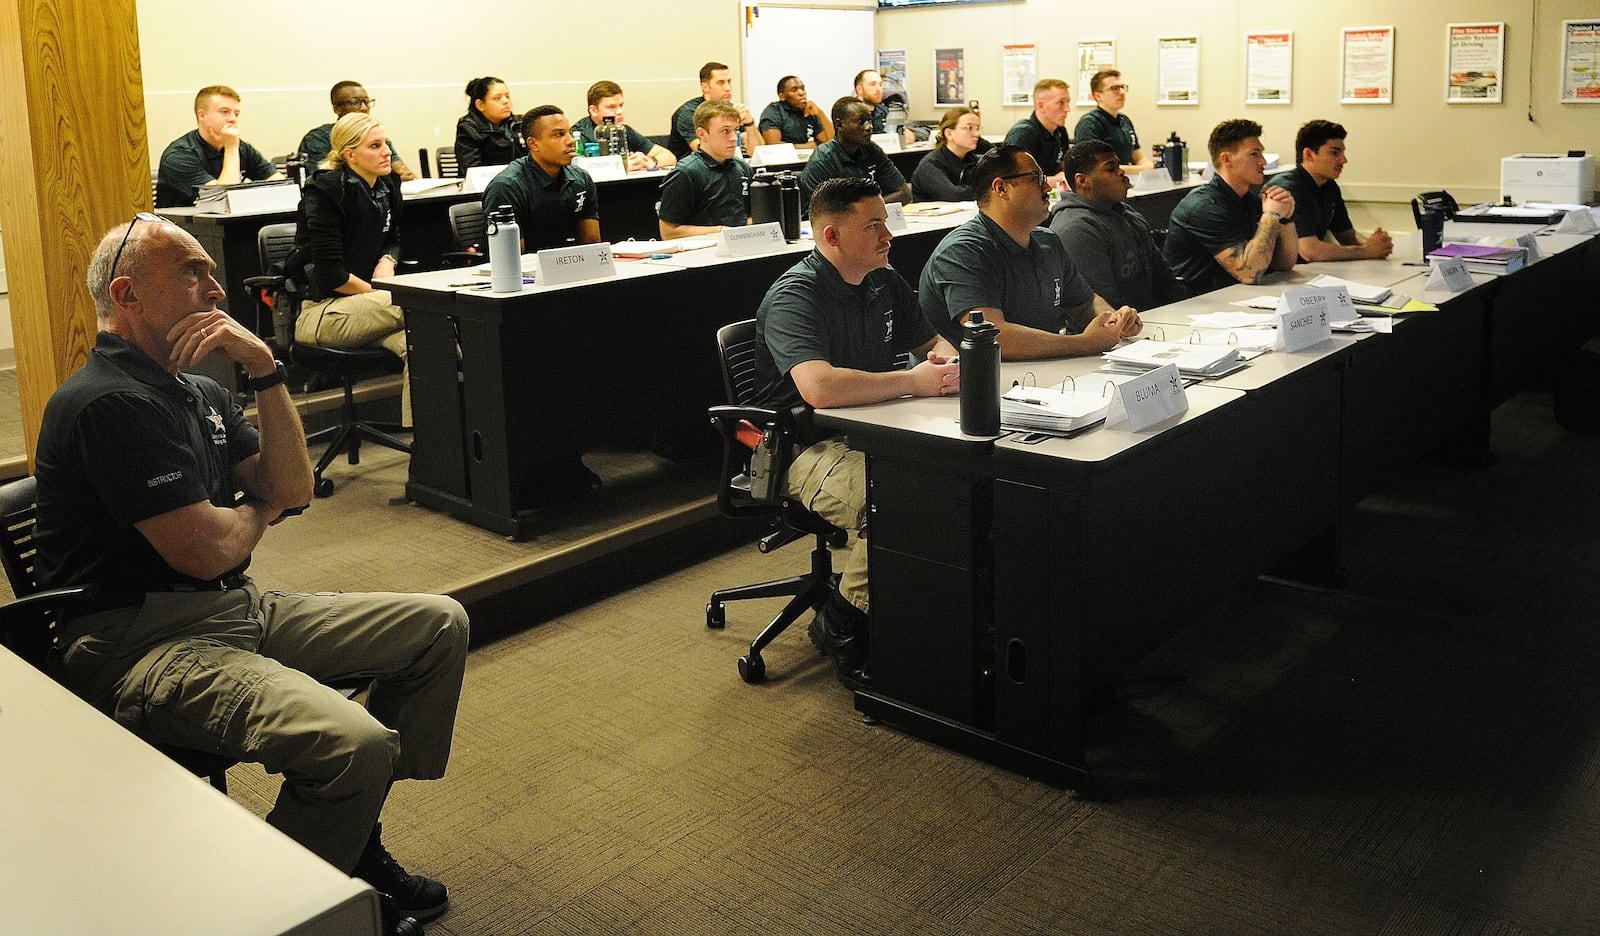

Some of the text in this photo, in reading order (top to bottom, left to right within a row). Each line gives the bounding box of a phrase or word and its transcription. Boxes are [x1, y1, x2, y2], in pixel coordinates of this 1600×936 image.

[729, 231, 766, 241] CUNNINGHAM
[555, 254, 585, 266] IRETON
[1299, 295, 1326, 306] OBERRY
[1290, 315, 1313, 331] SANCHEZ
[1135, 383, 1161, 402] BLUMA
[147, 470, 183, 488] INSTRUCTOR
